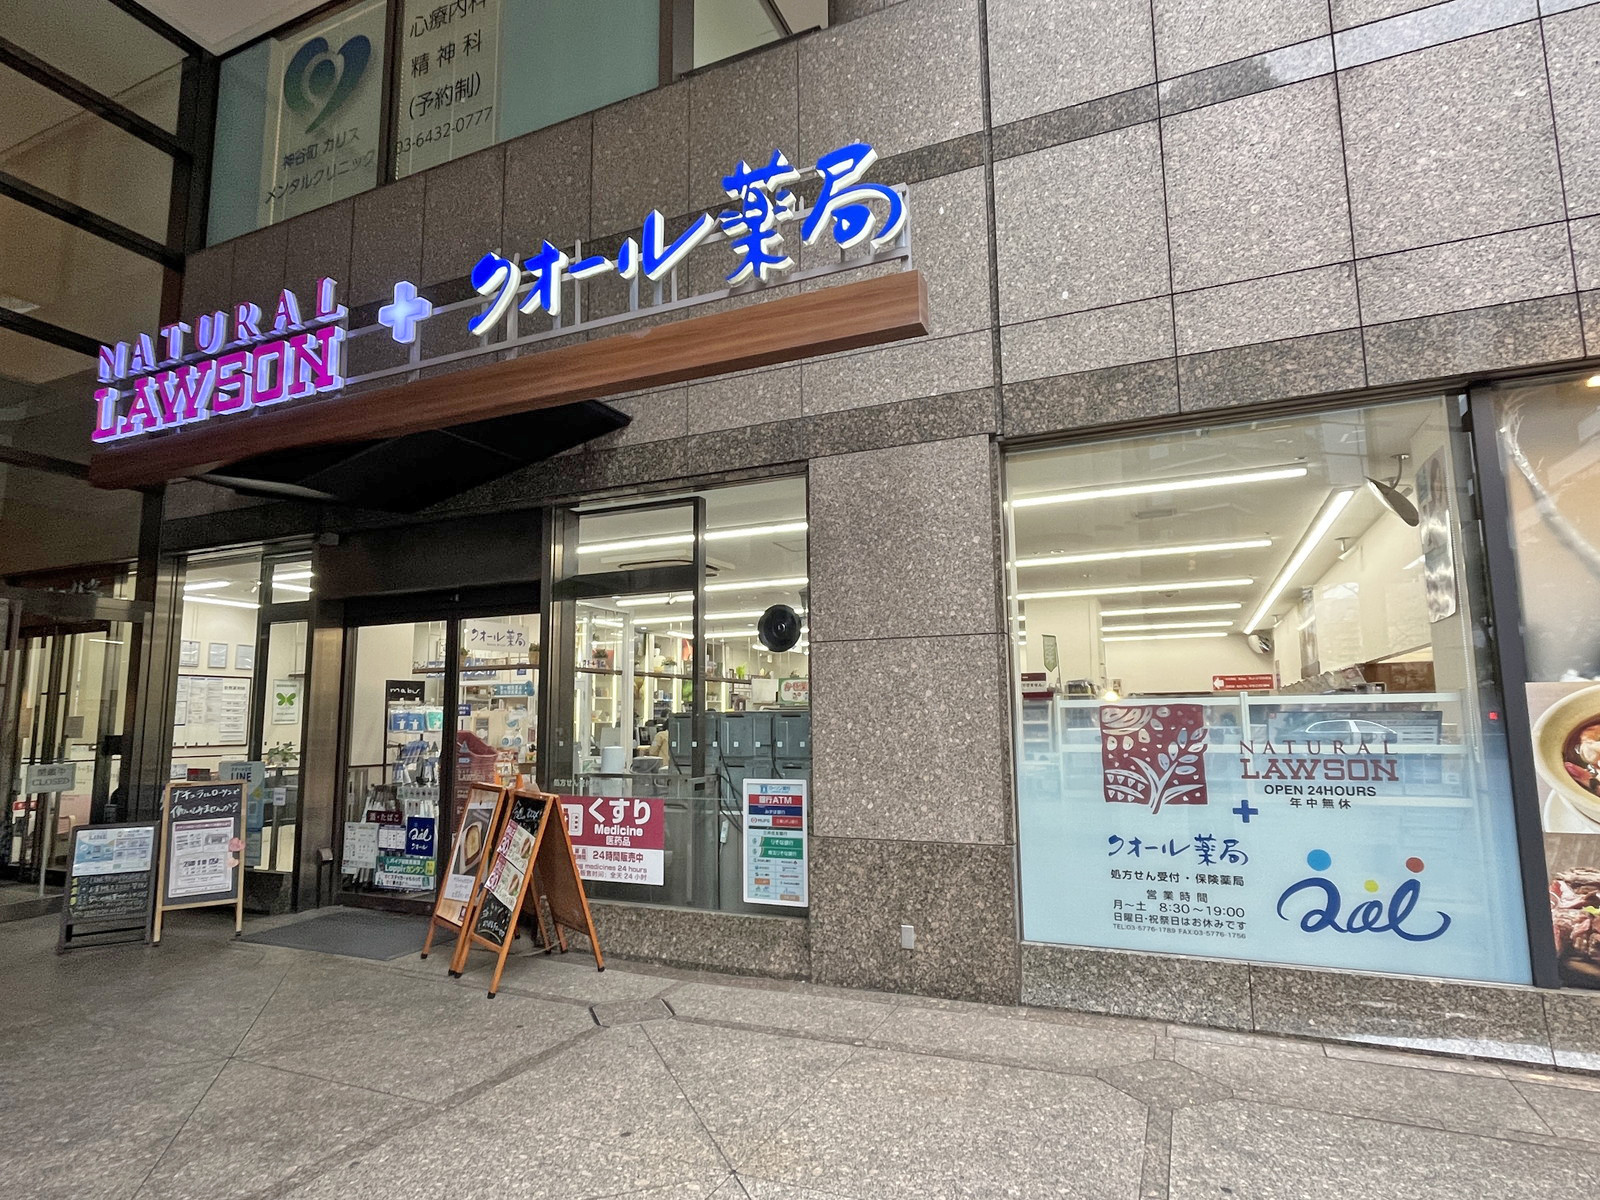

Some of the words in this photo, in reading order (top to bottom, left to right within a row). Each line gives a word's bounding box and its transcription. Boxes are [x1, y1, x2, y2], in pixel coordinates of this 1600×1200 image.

[411, 29, 482, 78] 精神科
[265, 150, 375, 204] メンタルクリニック
[468, 143, 908, 336] クオール薬局
[97, 276, 349, 383] NATURAL
[91, 326, 347, 443] LAWSON
[471, 628, 526, 647] クオール薬局
[1239, 739, 1399, 755] NATURAL
[1240, 758, 1399, 781] LAWSON
[32, 777, 70, 787] CLOSED
[1264, 784, 1303, 795] OPEN
[1307, 785, 1377, 797] 24HOURS
[588, 797, 651, 825] くすり
[1290, 797, 1352, 809] 年中無休
[594, 824, 644, 836] Medicine
[592, 850, 644, 863] 24時間販売中
[1108, 833, 1249, 866] クオール薬局
[1146, 889, 1209, 903] 営業時間
